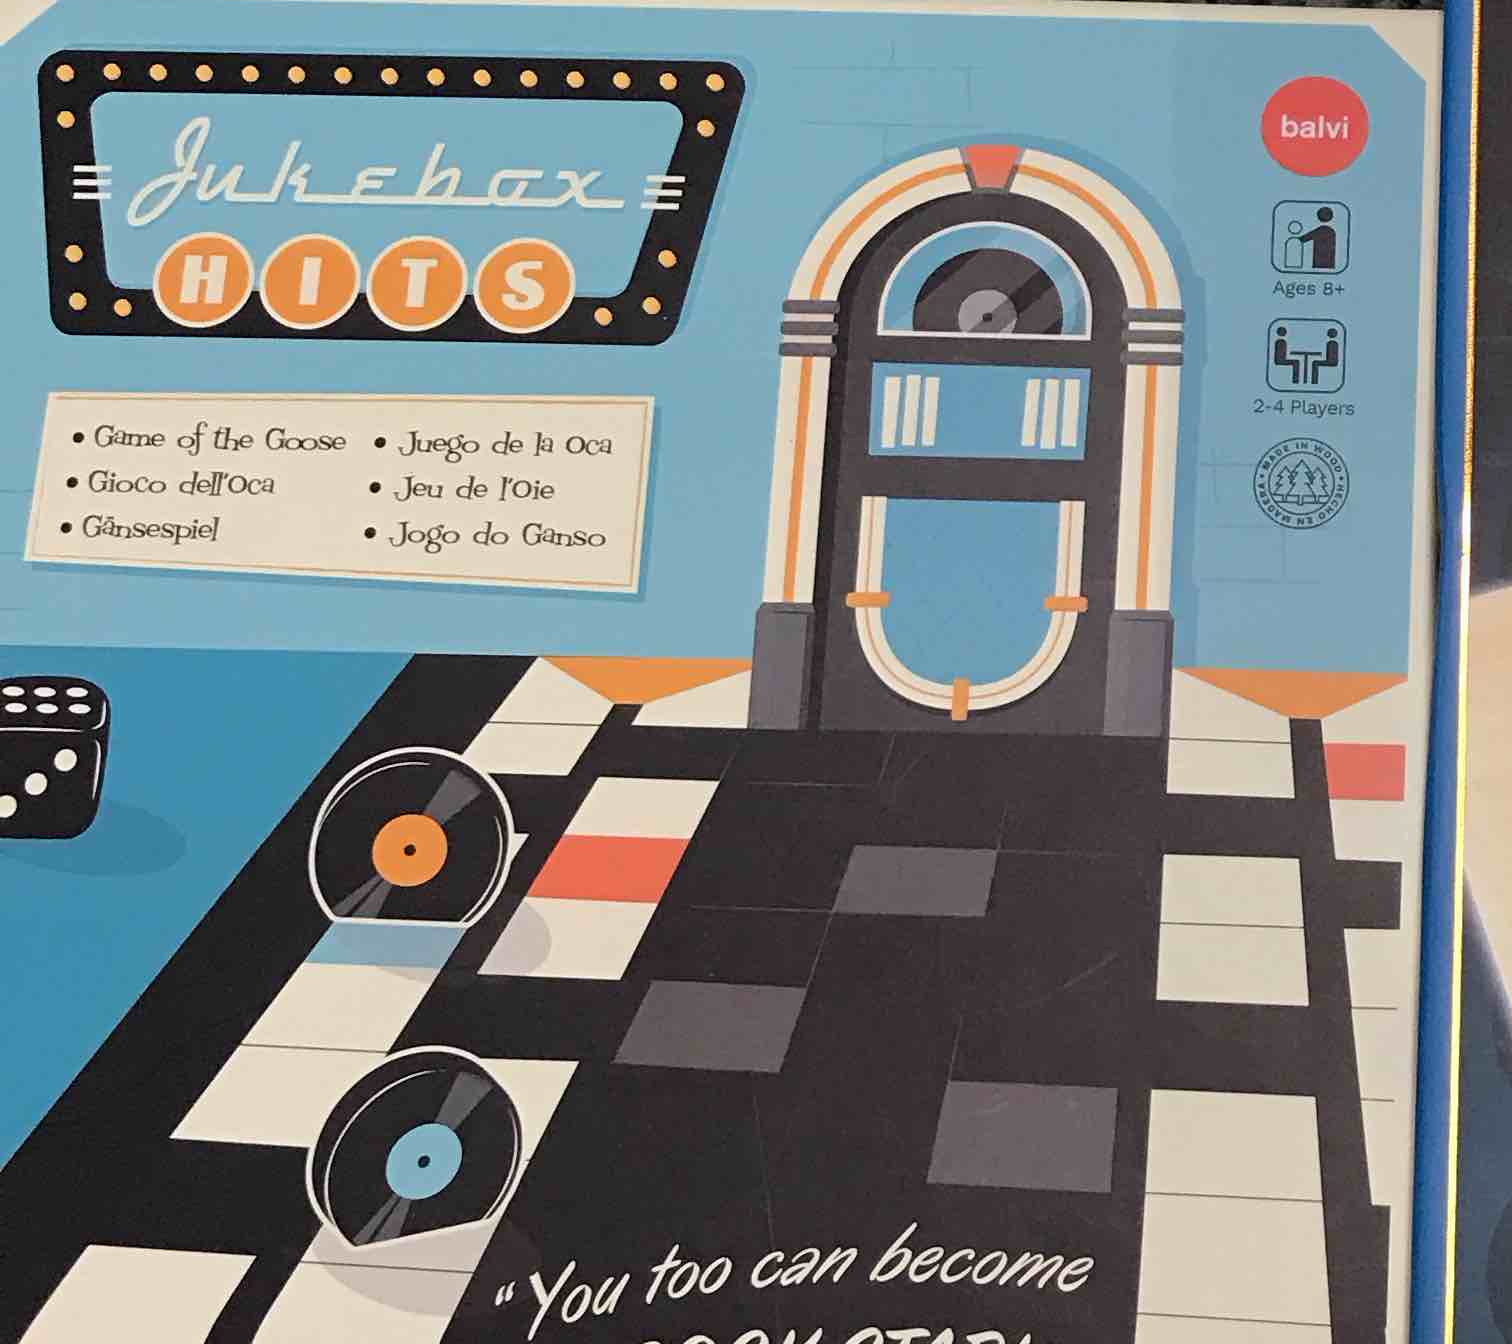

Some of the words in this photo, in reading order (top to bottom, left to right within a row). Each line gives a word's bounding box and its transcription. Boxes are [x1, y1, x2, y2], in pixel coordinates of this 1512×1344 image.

[1280, 113, 1349, 139] balvi
[127, 116, 625, 227] Jukebox
[180, 255, 545, 311] HITS
[1272, 280, 1317, 299] Ages
[1322, 282, 1345, 296] 8+
[1253, 398, 1285, 414] 2-4
[1291, 399, 1355, 418] Players
[94, 424, 166, 448] Game
[176, 421, 209, 456] of
[213, 427, 254, 451] the
[265, 427, 347, 451] Goose
[397, 430, 480, 463] Juego
[491, 431, 524, 456] de
[533, 431, 554, 456] la
[565, 435, 613, 456] Oca
[88, 469, 167, 494] Gioco
[178, 471, 277, 496] dell'Oca
[393, 475, 443, 501] Jeu
[455, 475, 488, 500] de
[388, 521, 460, 554] Jogo
[472, 521, 509, 546] do
[522, 522, 606, 547] Ganso
[645, 1244, 733, 1304] too
[750, 1245, 859, 1290] can
[869, 1222, 1095, 1293] become
